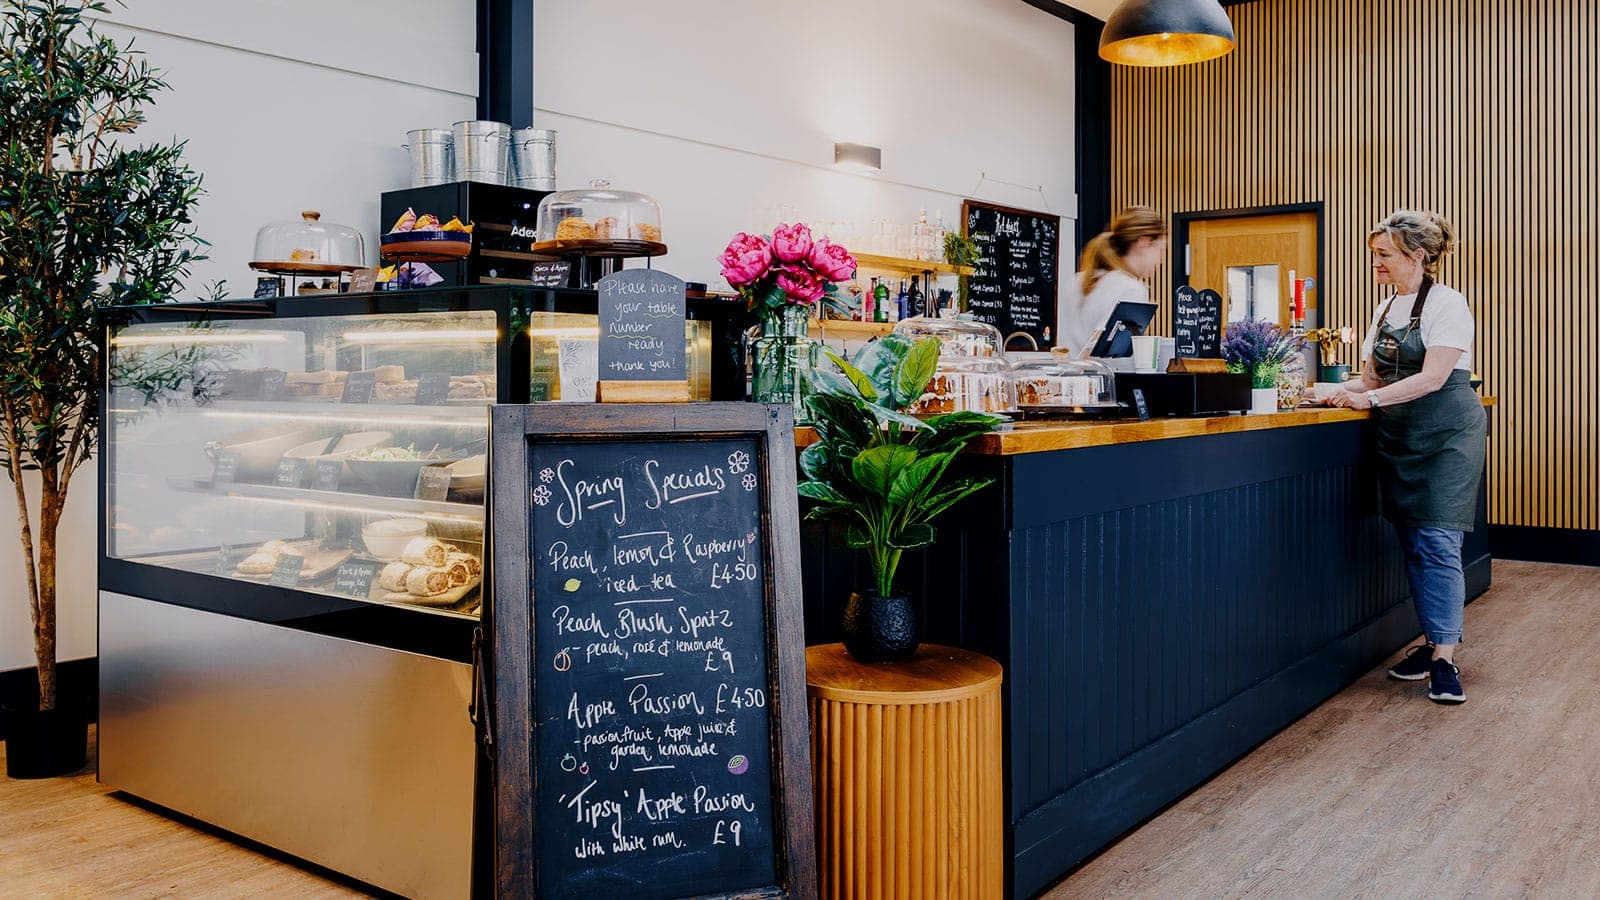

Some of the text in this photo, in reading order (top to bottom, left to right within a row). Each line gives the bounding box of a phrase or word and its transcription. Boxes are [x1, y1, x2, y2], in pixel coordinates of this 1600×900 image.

[604, 279, 680, 296] Please have
[615, 302, 678, 322] your table
[609, 321, 652, 334] number
[628, 338, 664, 356] ready
[608, 358, 676, 372] thank you!
[556, 459, 725, 527] Spring Specials
[613, 544, 658, 566] lemon
[659, 537, 676, 562] &
[683, 534, 746, 564] Raspberry
[606, 573, 676, 592] iced tea
[552, 606, 734, 640] Peach Blush Spritz
[658, 638, 670, 656] &
[676, 636, 726, 652] lemonade
[568, 692, 616, 728] Apple
[628, 684, 704, 715] Passion
[609, 742, 718, 770] garden lemonade
[637, 788, 686, 820] Apple
[694, 786, 755, 814] Passion
[612, 834, 646, 854] white
[652, 832, 687, 849] rum.
